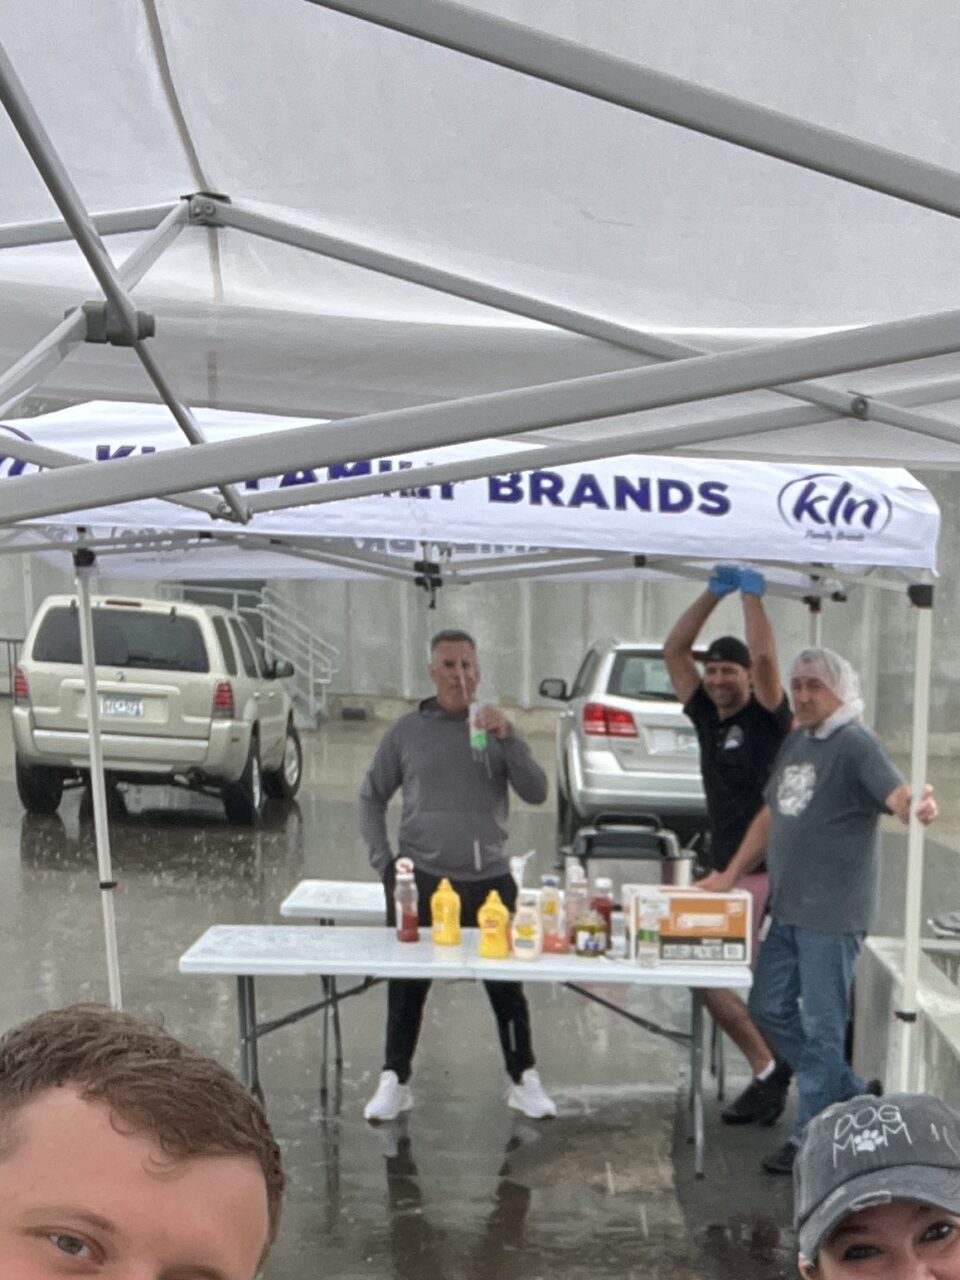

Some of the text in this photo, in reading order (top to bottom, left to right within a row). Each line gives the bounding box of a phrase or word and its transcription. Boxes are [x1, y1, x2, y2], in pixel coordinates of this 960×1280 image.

[488, 470, 731, 517] BRANDS
[792, 480, 880, 531] kln
[834, 1103, 902, 1141] DOG
